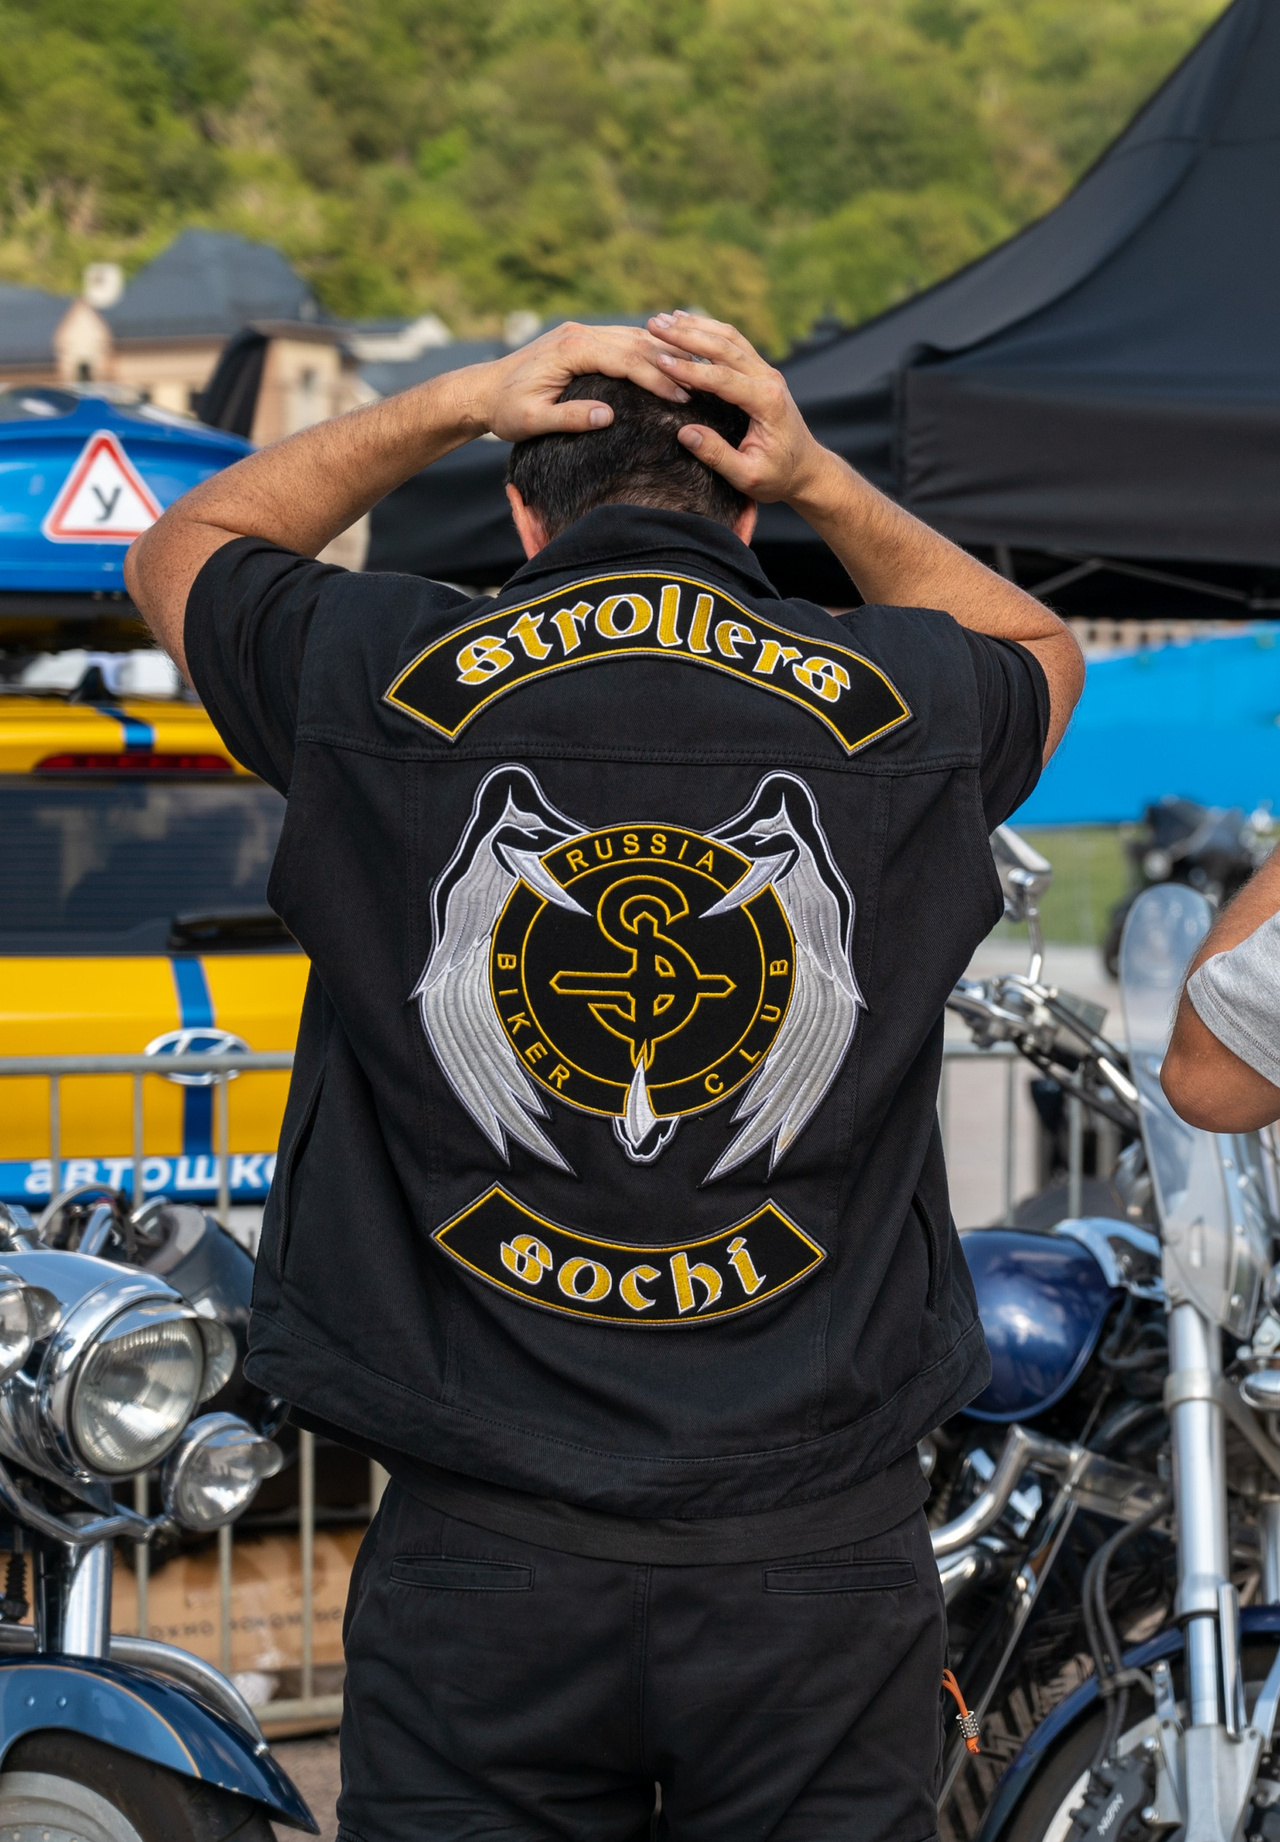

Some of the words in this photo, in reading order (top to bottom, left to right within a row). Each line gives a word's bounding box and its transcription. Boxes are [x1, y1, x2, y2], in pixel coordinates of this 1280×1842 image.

[566, 833, 715, 873] RUSSIA
[497, 953, 571, 1090] BIKER
[704, 958, 789, 1094] CLUB
